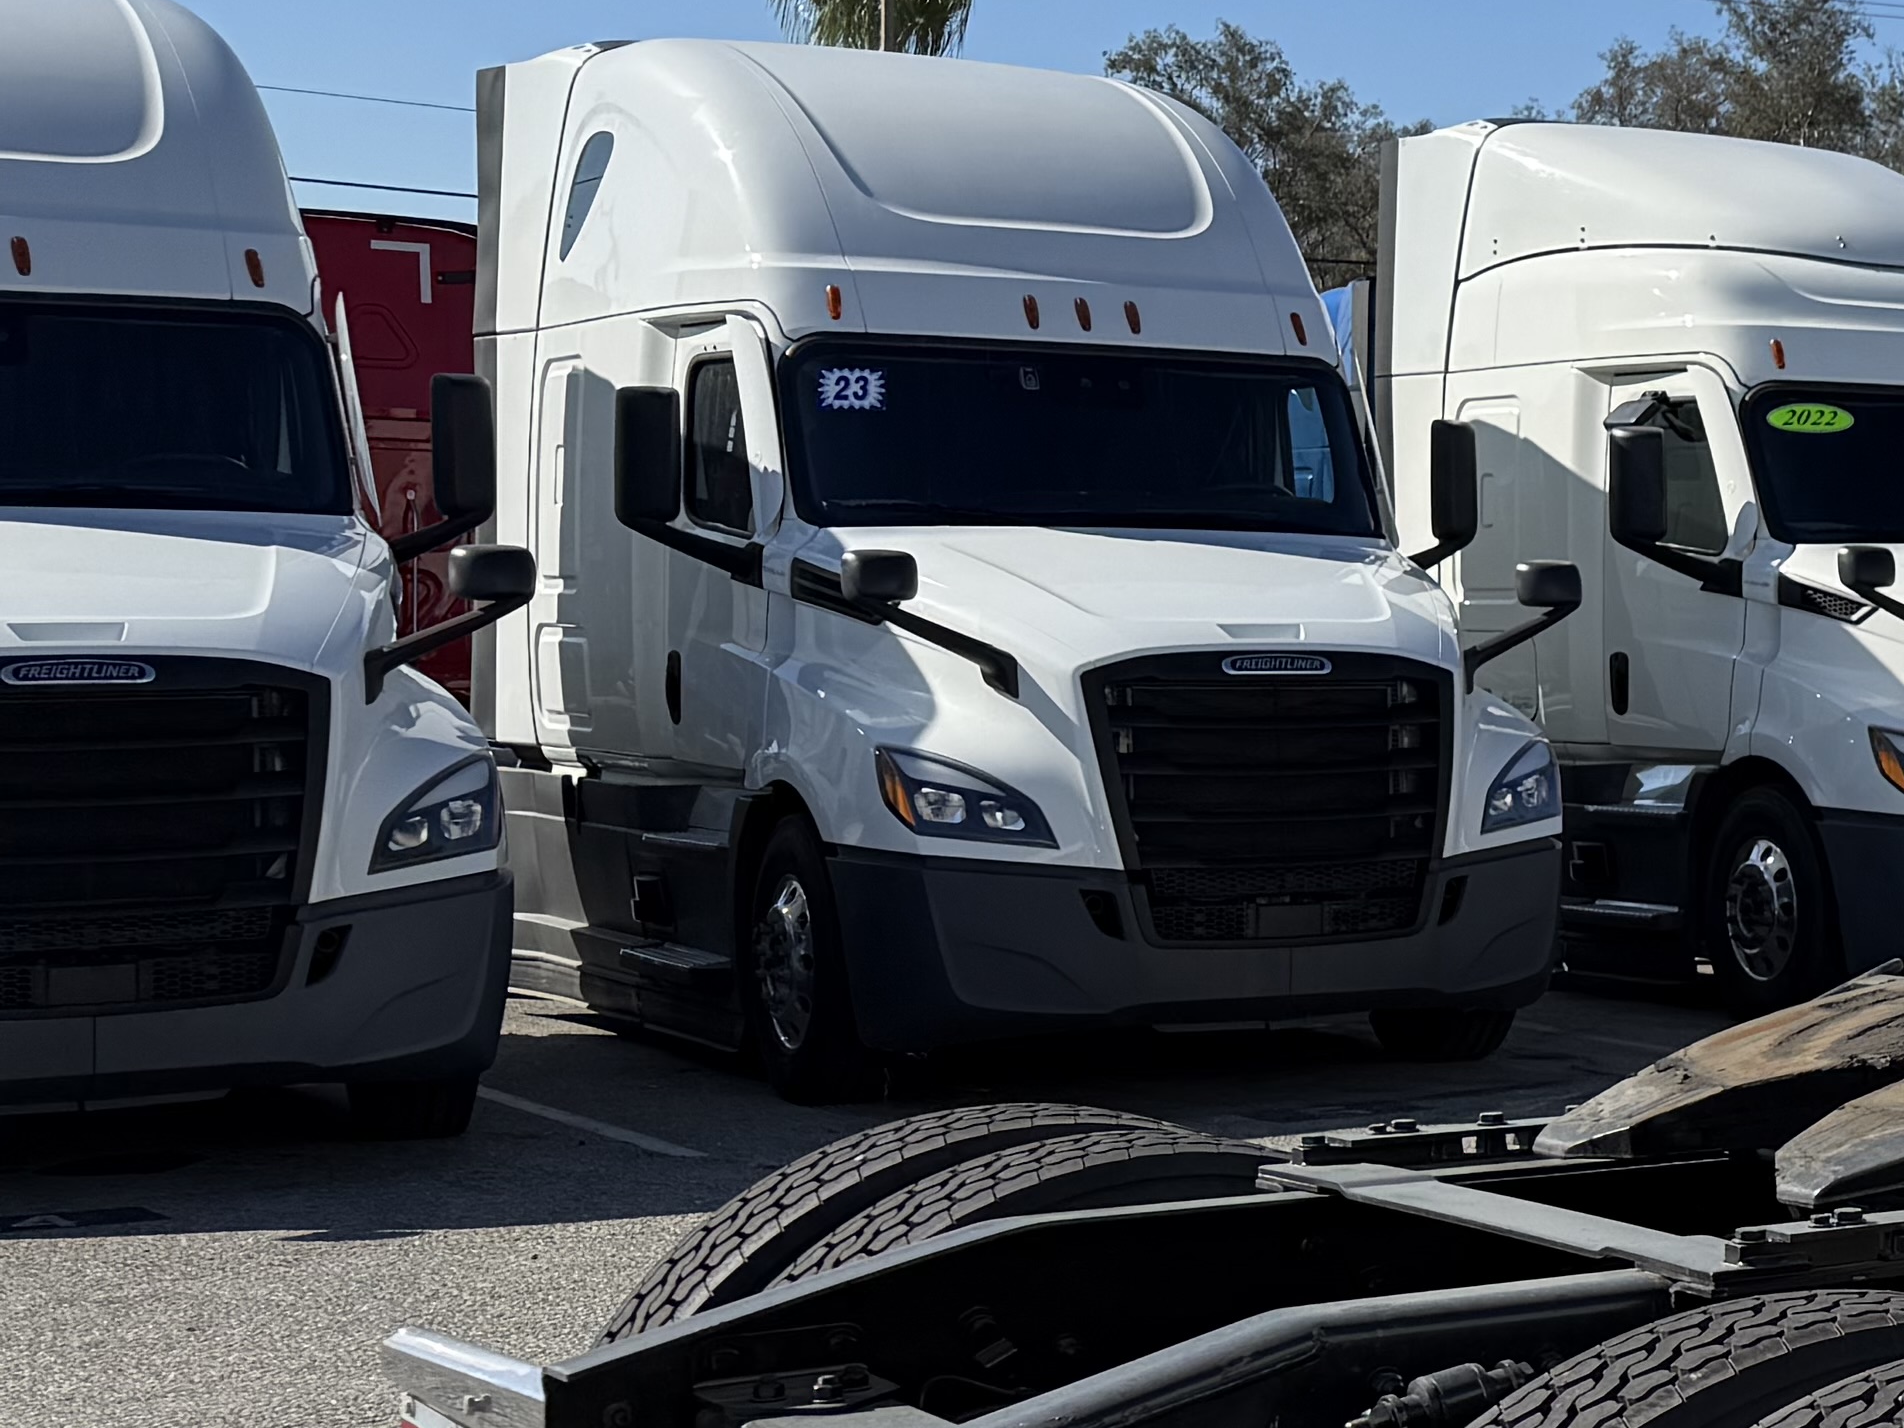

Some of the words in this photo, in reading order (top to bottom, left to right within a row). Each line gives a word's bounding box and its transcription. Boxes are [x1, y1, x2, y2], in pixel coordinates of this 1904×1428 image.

[832, 375, 869, 401] 23
[1782, 408, 1838, 426] 2022
[18, 664, 139, 678] FREIGHTLINER
[1235, 657, 1321, 669] FREIGHTLINER
